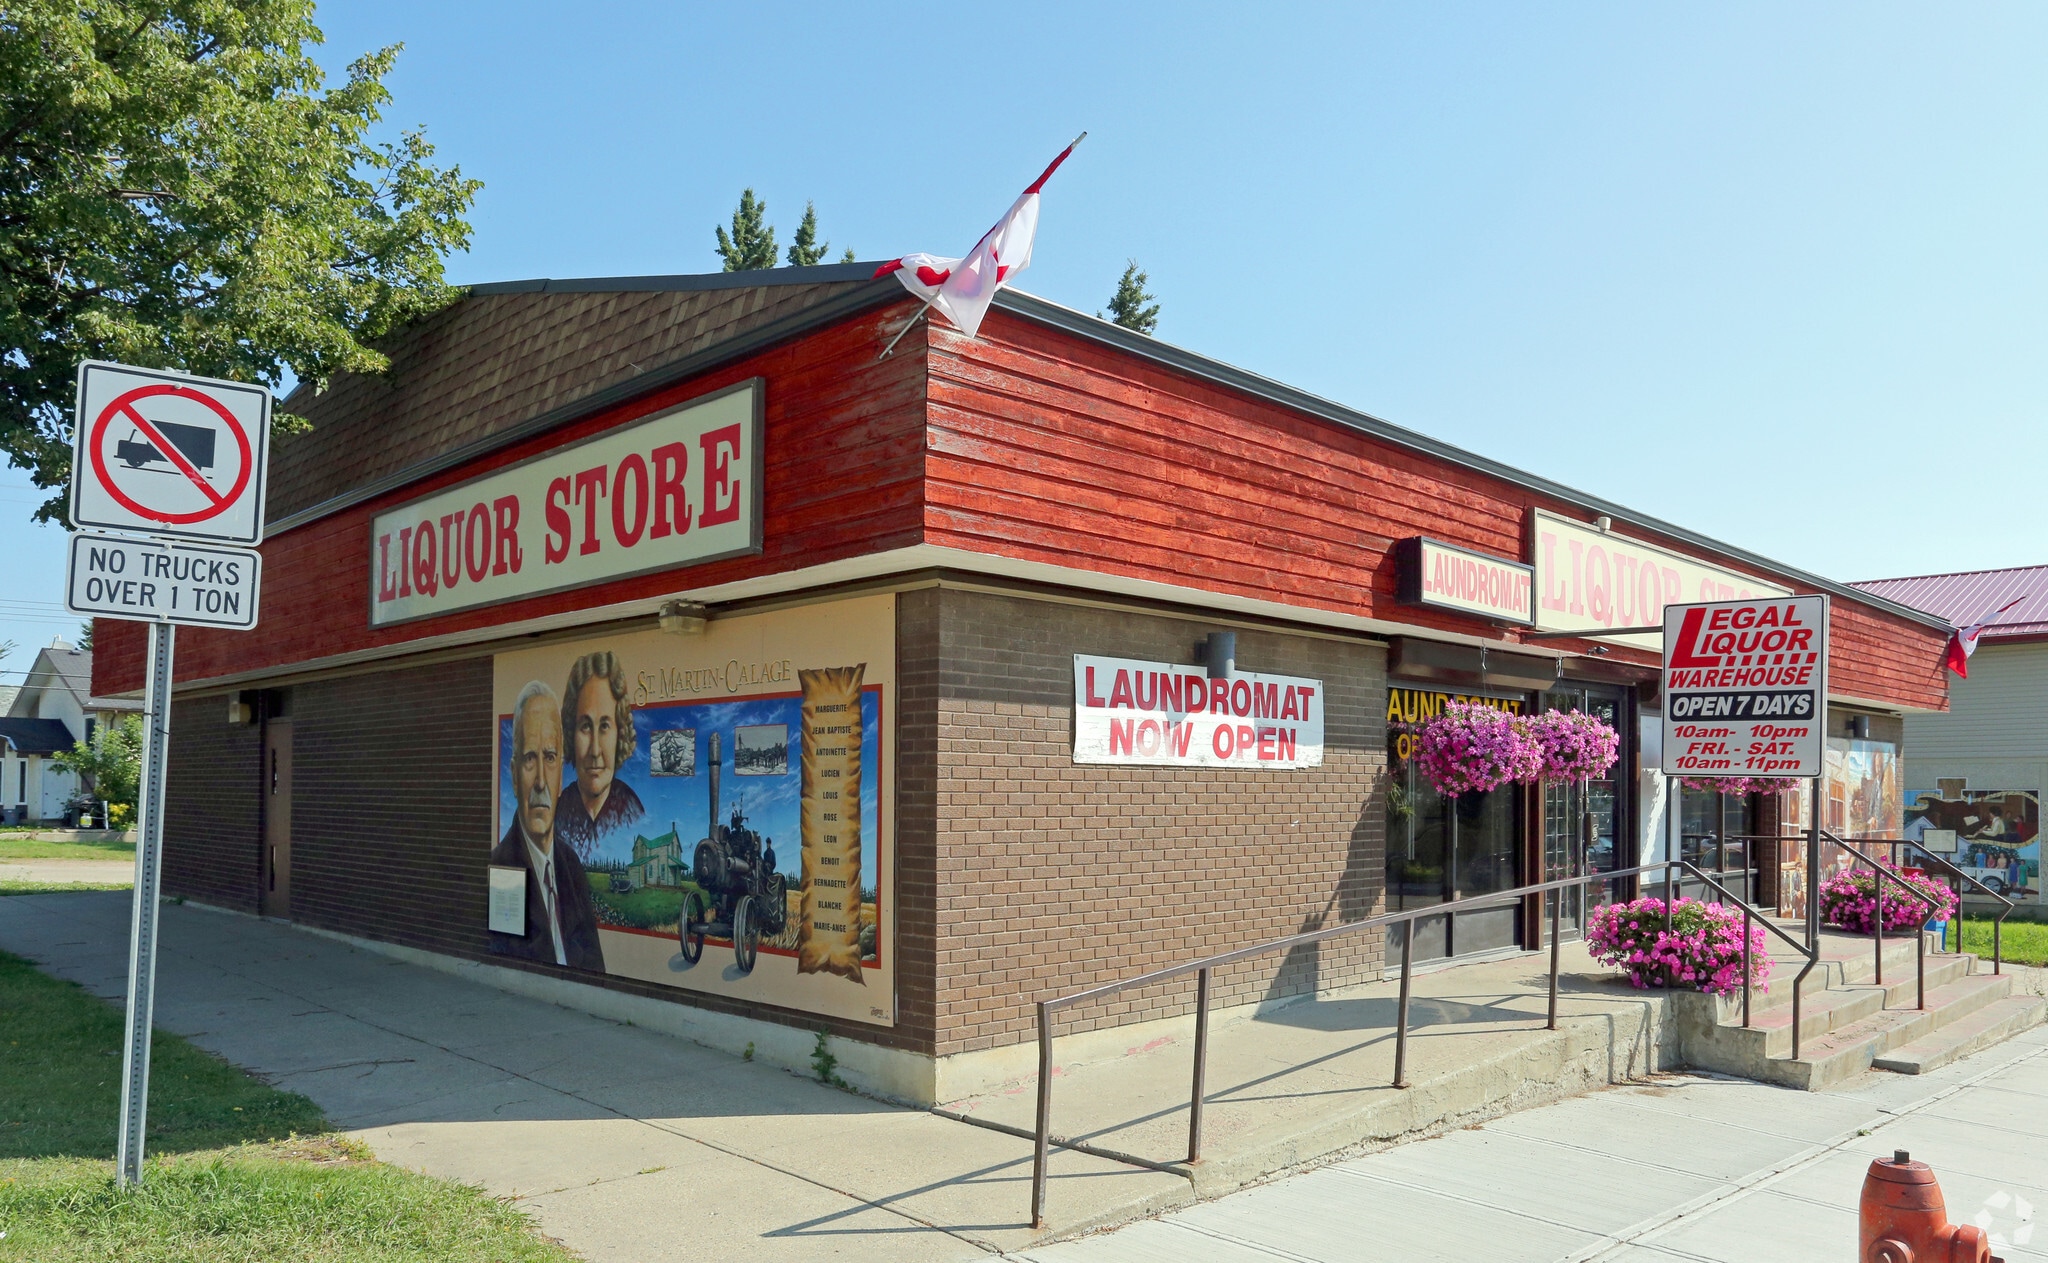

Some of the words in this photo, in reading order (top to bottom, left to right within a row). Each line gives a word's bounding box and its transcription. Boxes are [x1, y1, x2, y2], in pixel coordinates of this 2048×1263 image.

[378, 494, 523, 603] LIQUOR
[545, 422, 741, 566] STORE
[89, 547, 126, 574] NO
[141, 553, 240, 586] TRUCKS
[1423, 549, 1531, 614] LAUNDROMAT
[1541, 531, 1682, 628] LIQUOR
[86, 577, 156, 608] OVER
[171, 586, 178, 609] 1
[193, 588, 240, 615] TON
[1669, 605, 1802, 668] LEGAL
[1668, 666, 1813, 688] WAREHOUSE
[1085, 666, 1315, 722] LAUNDROMAT
[815, 704, 848, 713] MARGUERITE
[1673, 696, 1734, 717] OPEN
[1735, 696, 1750, 715] 7
[1752, 694, 1811, 716] DAYS
[827, 726, 852, 735] BAPTISTE
[1750, 724, 1808, 740] 10pm
[1109, 718, 1193, 758] NOW
[1212, 723, 1296, 761] OPEN
[816, 748, 847, 756] ANTOINETTE
[1687, 743, 1729, 755] FRI.
[1747, 742, 1794, 755] SAT.
[821, 769, 840, 777] LUCIEN
[823, 791, 838, 799] LOUIS
[823, 813, 837, 821] ROSE
[823, 835, 837, 843] LEON
[821, 857, 840, 865] BENOIT
[814, 878, 846, 888] BERNADETTE
[818, 900, 842, 910] BLANCHE
[814, 921, 846, 932] MARIE-ANGE
